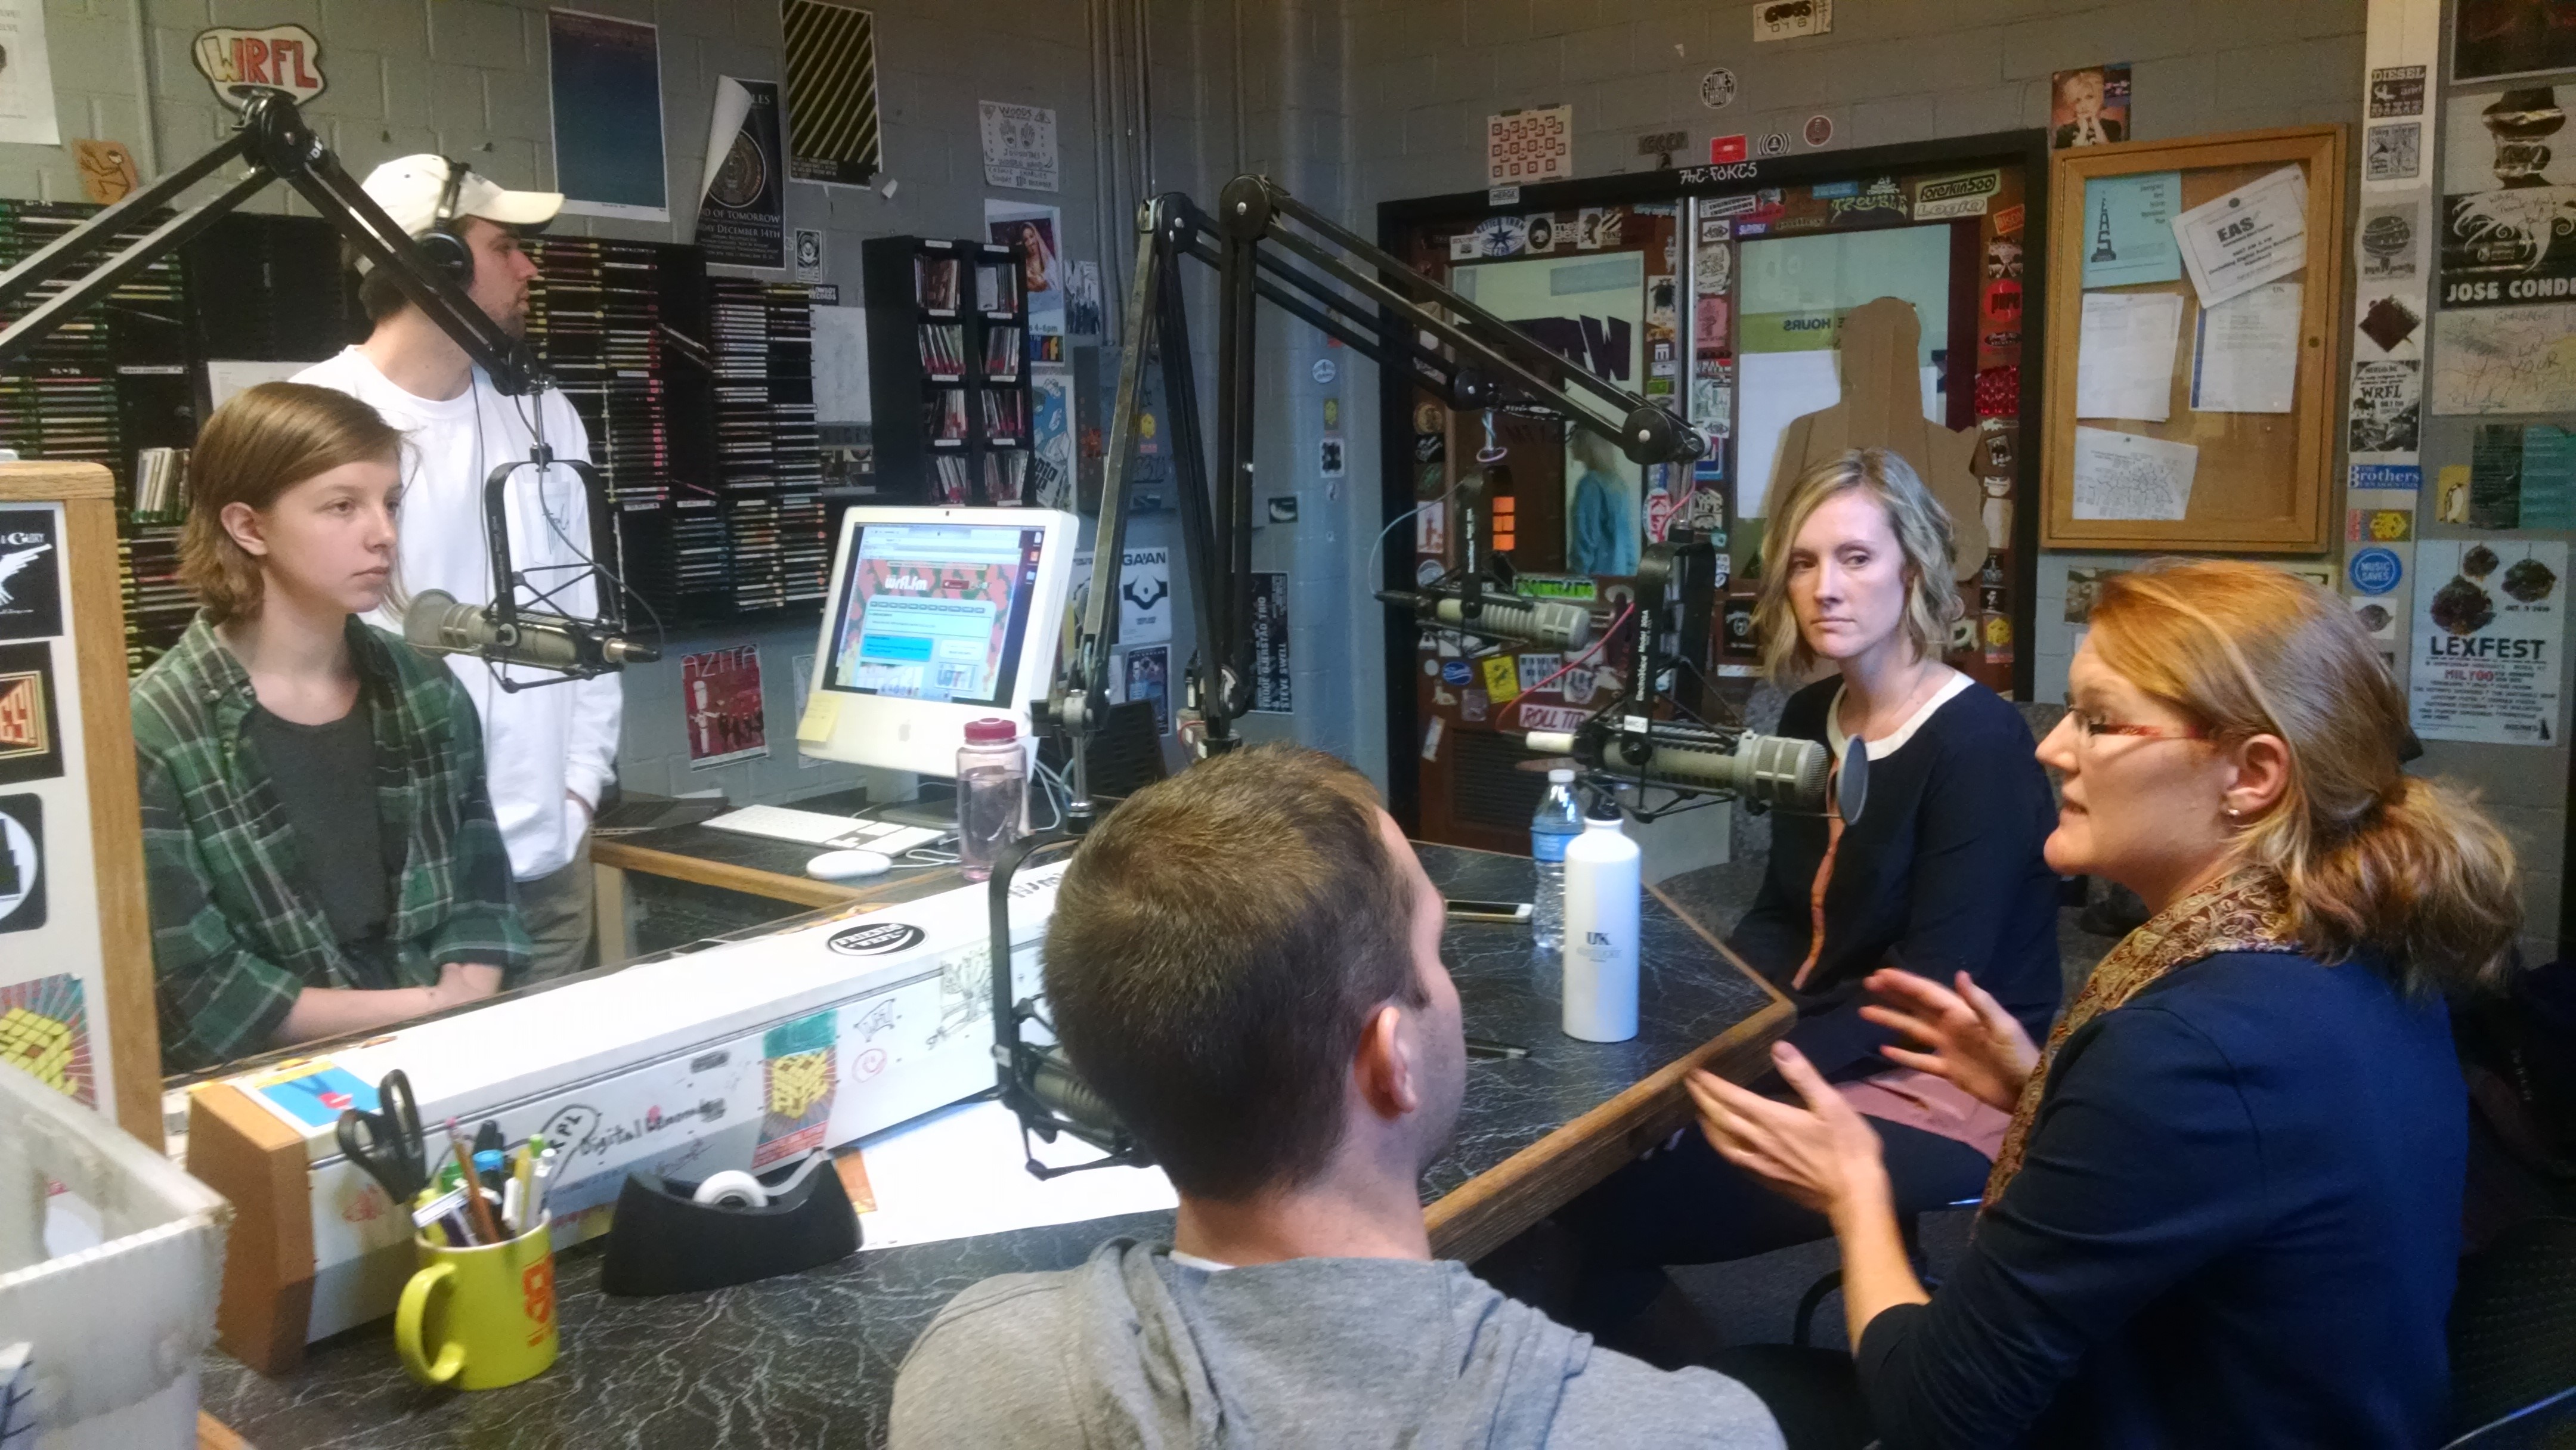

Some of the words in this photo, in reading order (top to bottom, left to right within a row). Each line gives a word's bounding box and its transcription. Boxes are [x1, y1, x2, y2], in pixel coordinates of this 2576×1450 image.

[202, 36, 318, 88] WRFL
[2373, 67, 2425, 82] DIESEL
[713, 210, 724, 218] OF
[727, 210, 780, 223] TOMORROW
[717, 224, 758, 236] DECEMBER
[2216, 216, 2255, 243] EAS
[2447, 282, 2499, 302] JOSE
[2360, 385, 2402, 399] WRFL
[1123, 552, 1166, 566] GA'AN
[2431, 636, 2546, 659] LEXFEST
[1523, 707, 1559, 728] ROLL
[1585, 931, 1612, 945] UK
